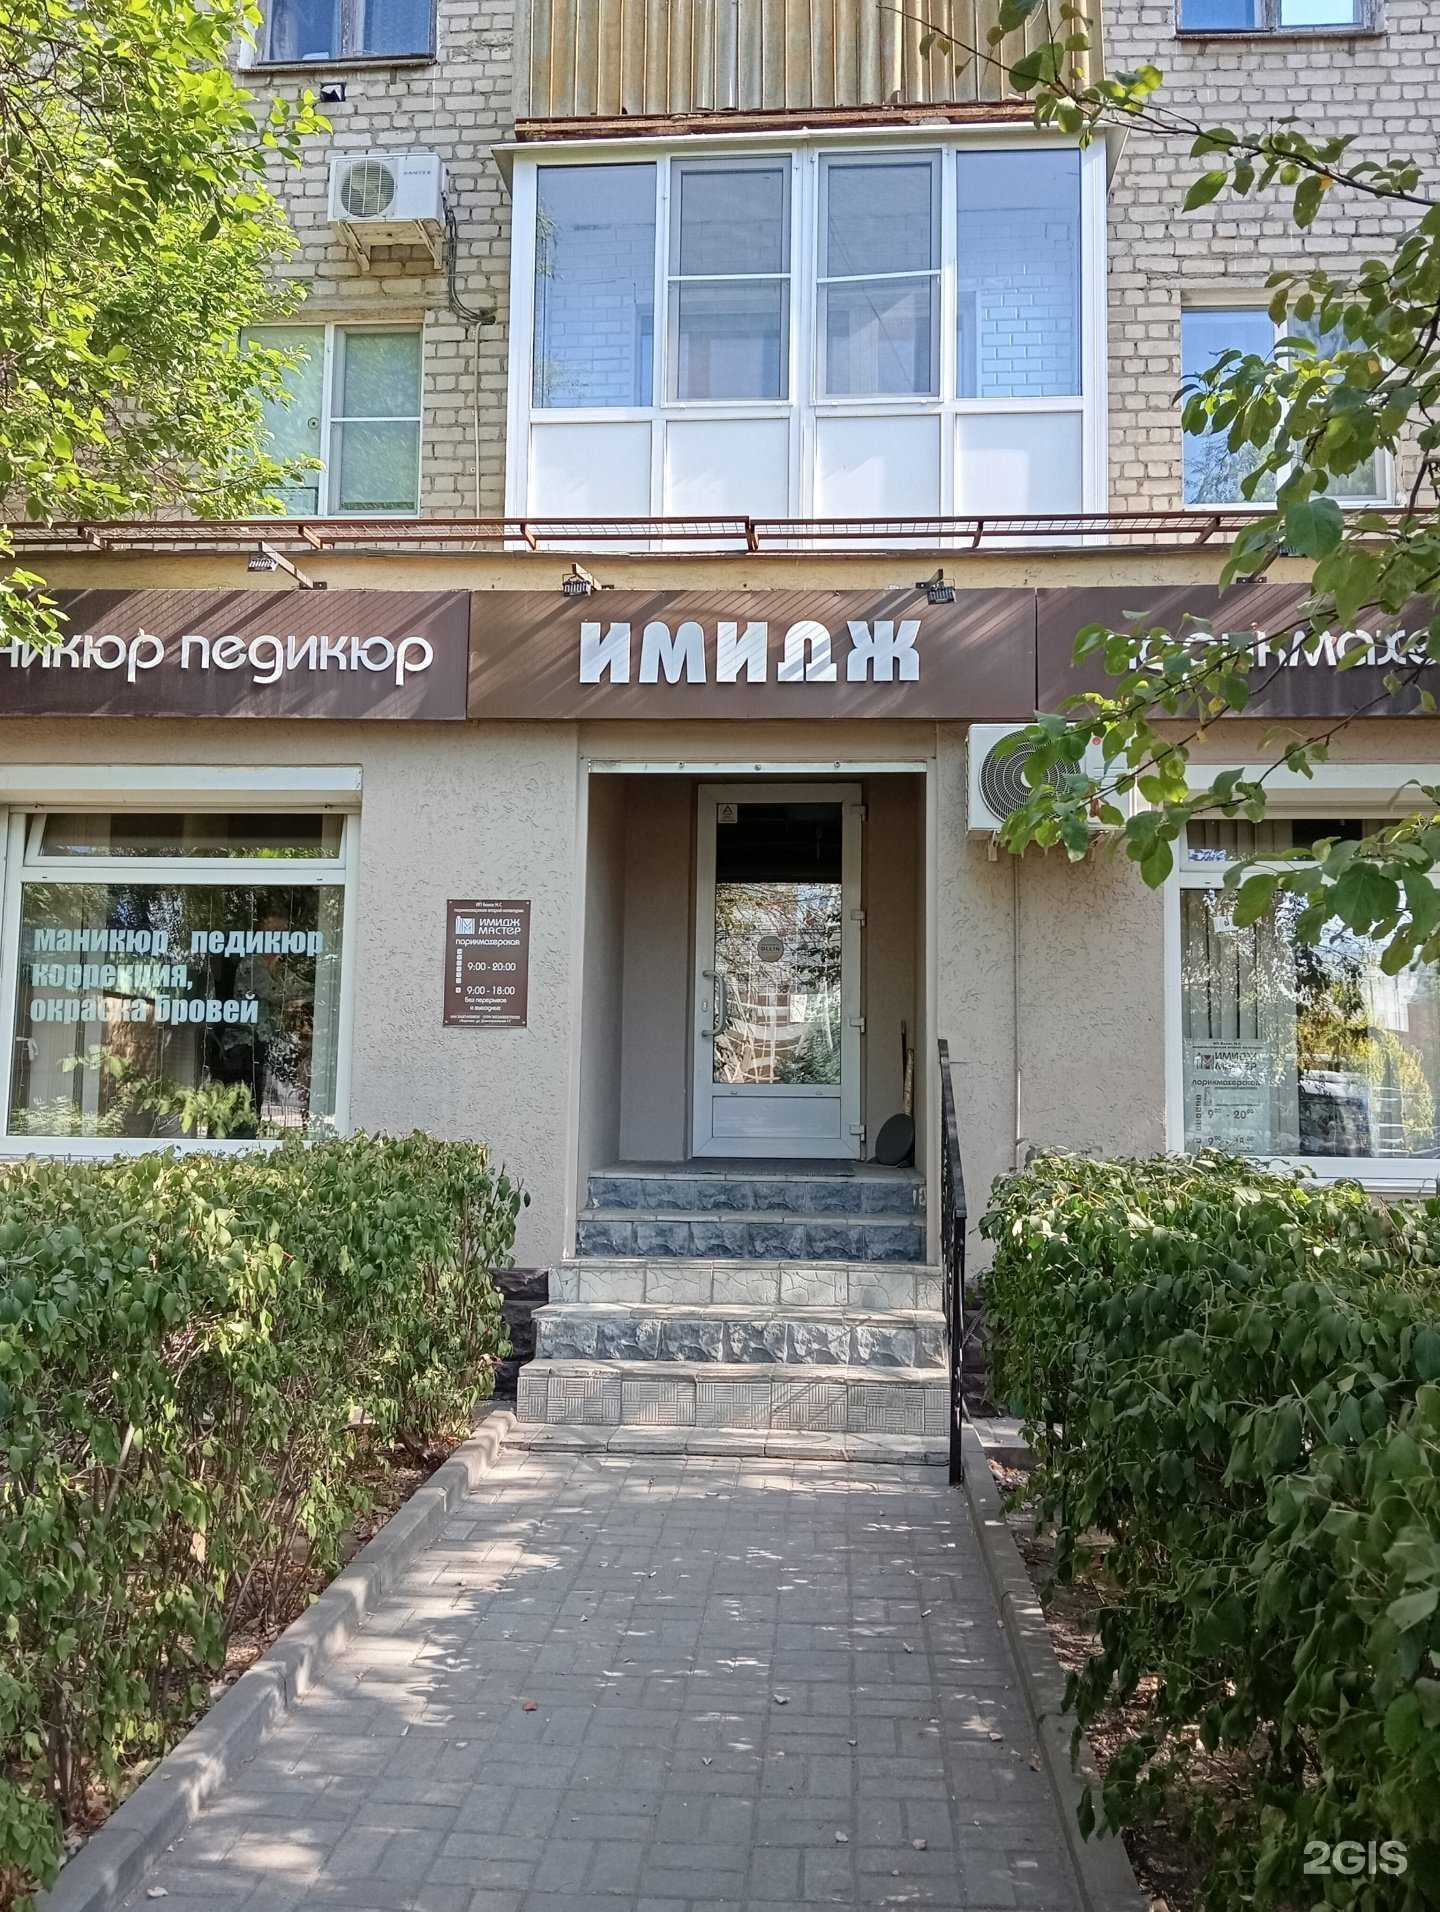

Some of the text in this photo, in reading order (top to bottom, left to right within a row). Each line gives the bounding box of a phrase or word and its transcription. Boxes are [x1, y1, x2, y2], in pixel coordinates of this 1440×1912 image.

[181, 635, 434, 686] педикюр
[579, 620, 921, 684] ИМИДЖ
[479, 918, 520, 927] ИМИДЖ
[34, 929, 324, 957] маникюр педикюр
[467, 962, 486, 971] 9:00
[492, 962, 516, 971] 20:00
[466, 986, 485, 995] 9:00
[492, 986, 516, 995] 18:00
[30, 992, 259, 1025] окраска бровей
